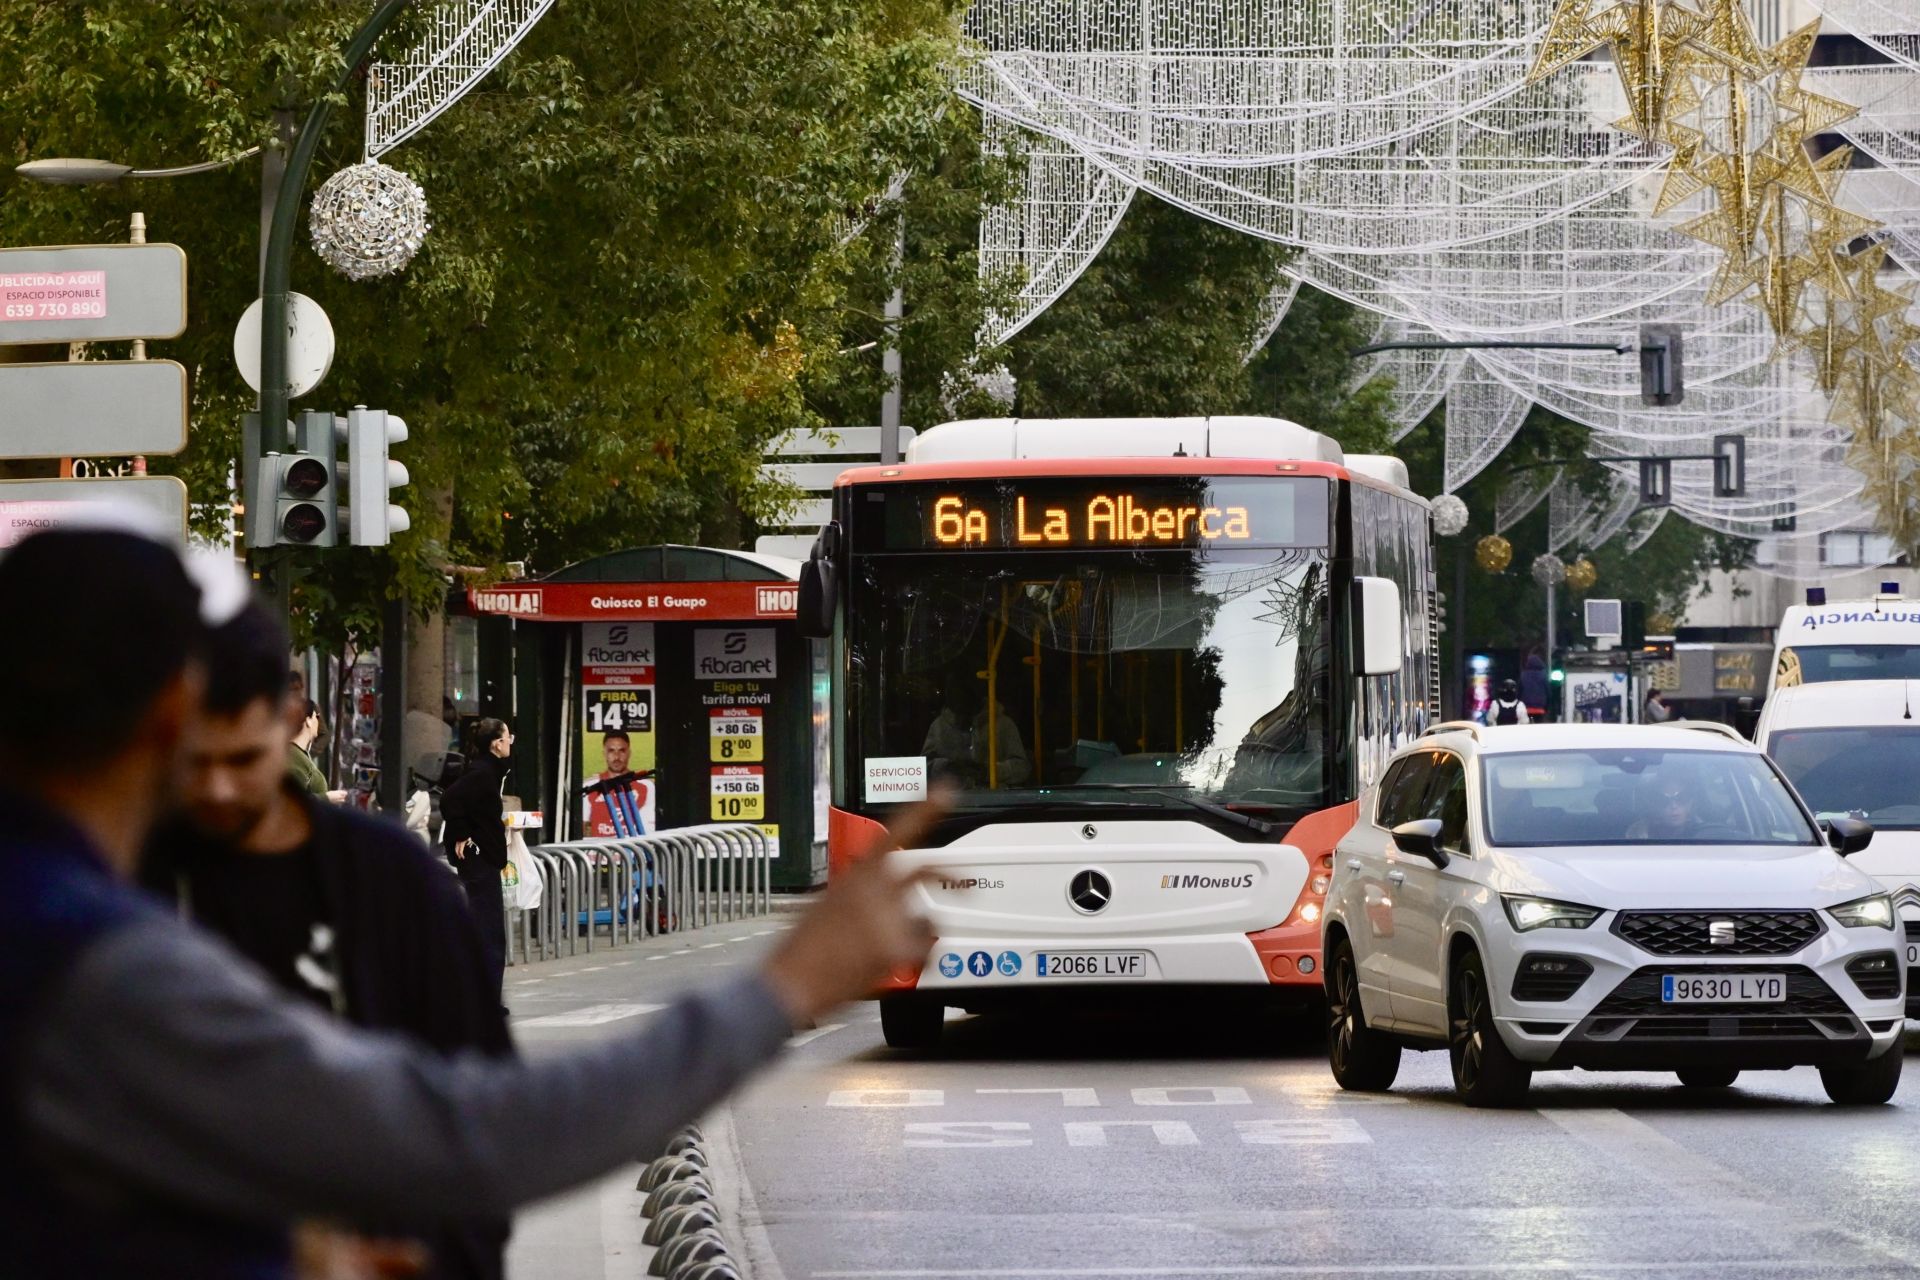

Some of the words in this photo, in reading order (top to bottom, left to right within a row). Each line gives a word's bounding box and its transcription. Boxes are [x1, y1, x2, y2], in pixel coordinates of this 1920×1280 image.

[68, 273, 100, 285] AQUÍ
[6, 291, 45, 300] ESPACIO
[48, 289, 101, 299] DISPONIBLE
[6, 304, 34, 317] 639
[38, 303, 67, 316] 730
[71, 302, 100, 315] 890
[11, 519, 50, 528] ESPACIO
[1018, 496, 1069, 541] La
[1088, 496, 1249, 541] Alberca
[591, 596, 642, 609] Quiosco
[647, 595, 658, 607] El
[663, 595, 707, 610] Guapo
[588, 647, 650, 662] fibranet
[700, 657, 772, 674] fibranet
[713, 682, 743, 694] Elige
[746, 682, 759, 692] tu
[600, 692, 638, 702] FIBRA
[702, 694, 734, 705] tarifa
[738, 693, 771, 704] móvil
[742, 724, 757, 734] Gb
[869, 767, 922, 777] SERVICIOS
[746, 782, 760, 792] Gb
[872, 782, 920, 792] MÍNIMOS
[1051, 956, 1098, 974] 2066
[1105, 956, 1140, 974] LVF
[1677, 979, 1732, 999] 9630
[1740, 979, 1781, 999] LYD
